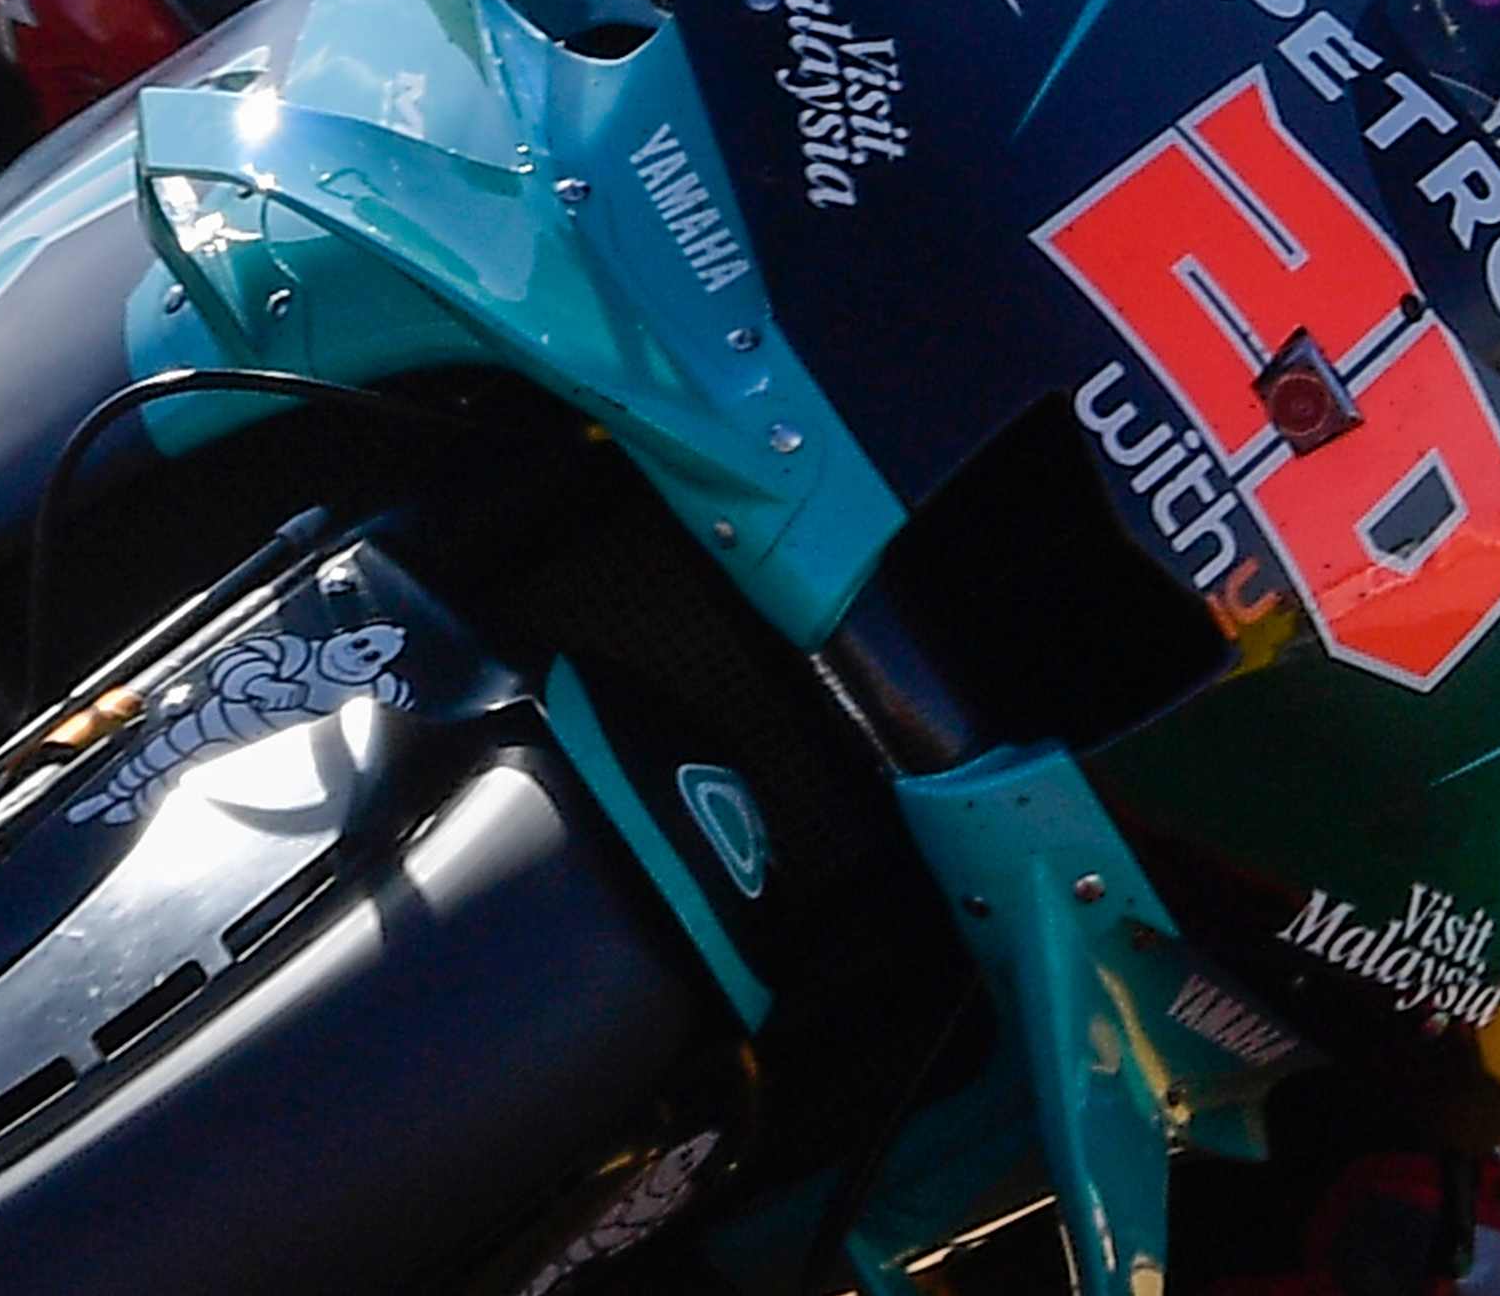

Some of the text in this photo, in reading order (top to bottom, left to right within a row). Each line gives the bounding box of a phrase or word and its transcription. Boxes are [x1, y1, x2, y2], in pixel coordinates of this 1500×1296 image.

[839, 38, 910, 160] Visit
[628, 124, 750, 293] YAMAHA
[1401, 882, 1495, 968] Visit
